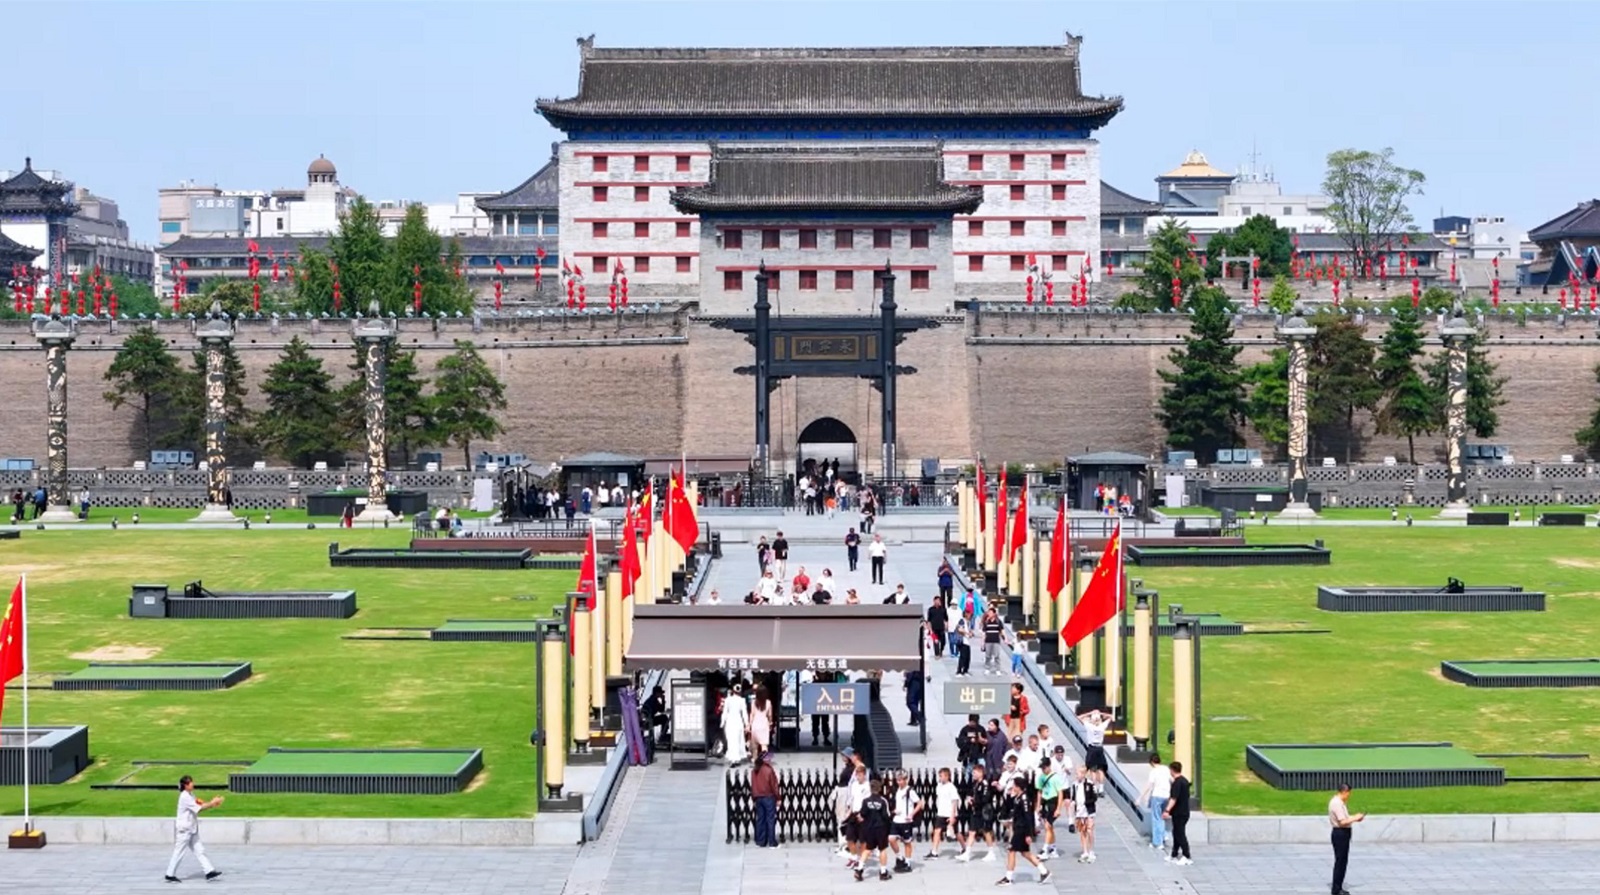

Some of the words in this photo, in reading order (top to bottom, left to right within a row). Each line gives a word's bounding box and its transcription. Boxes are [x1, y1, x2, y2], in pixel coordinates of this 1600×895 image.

[717, 658, 759, 669] 有包通道
[806, 658, 848, 669] 无包通道
[817, 687, 855, 703] 入口
[960, 687, 995, 703] 出口
[816, 704, 855, 712] ENTRANCE
